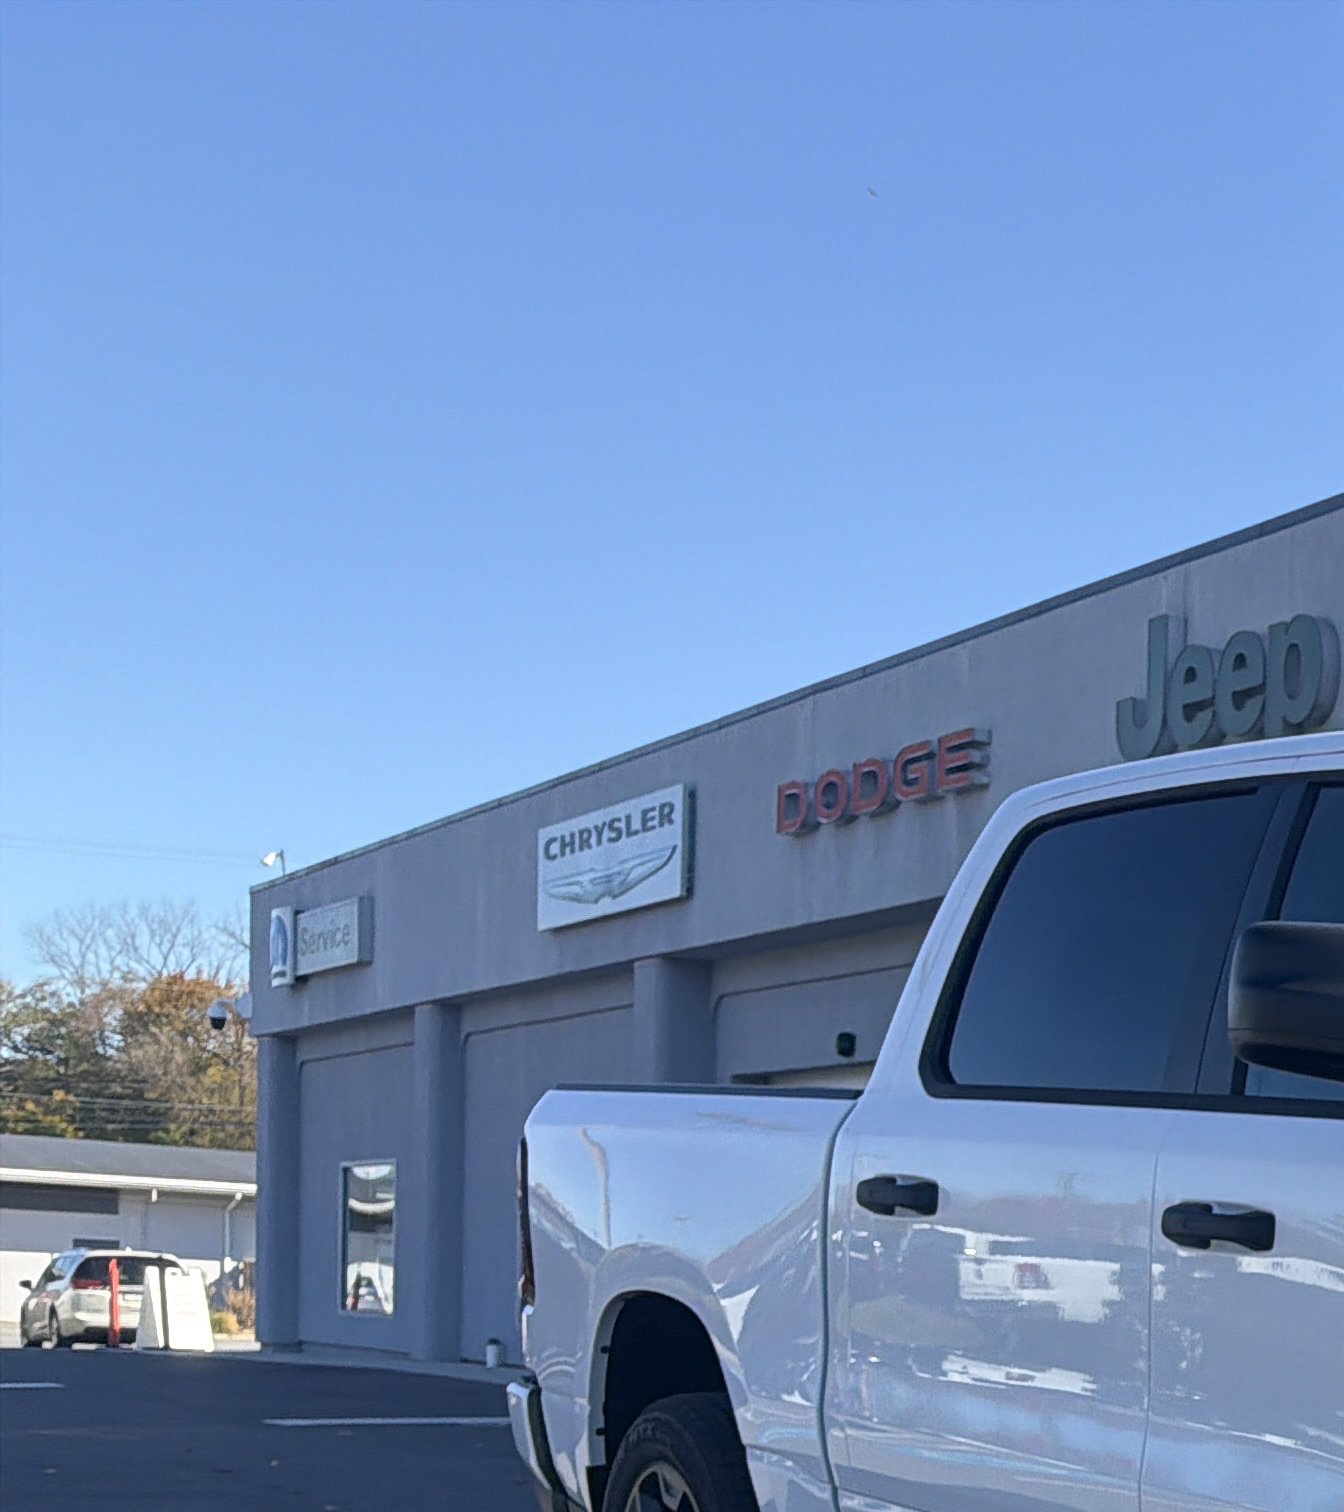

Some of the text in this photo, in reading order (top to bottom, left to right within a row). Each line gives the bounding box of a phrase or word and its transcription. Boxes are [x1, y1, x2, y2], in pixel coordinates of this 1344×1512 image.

[1116, 613, 1340, 761] Jeep
[776, 727, 990, 836] DODGE
[544, 800, 675, 862] CHRYSLER
[299, 918, 352, 957] Service
